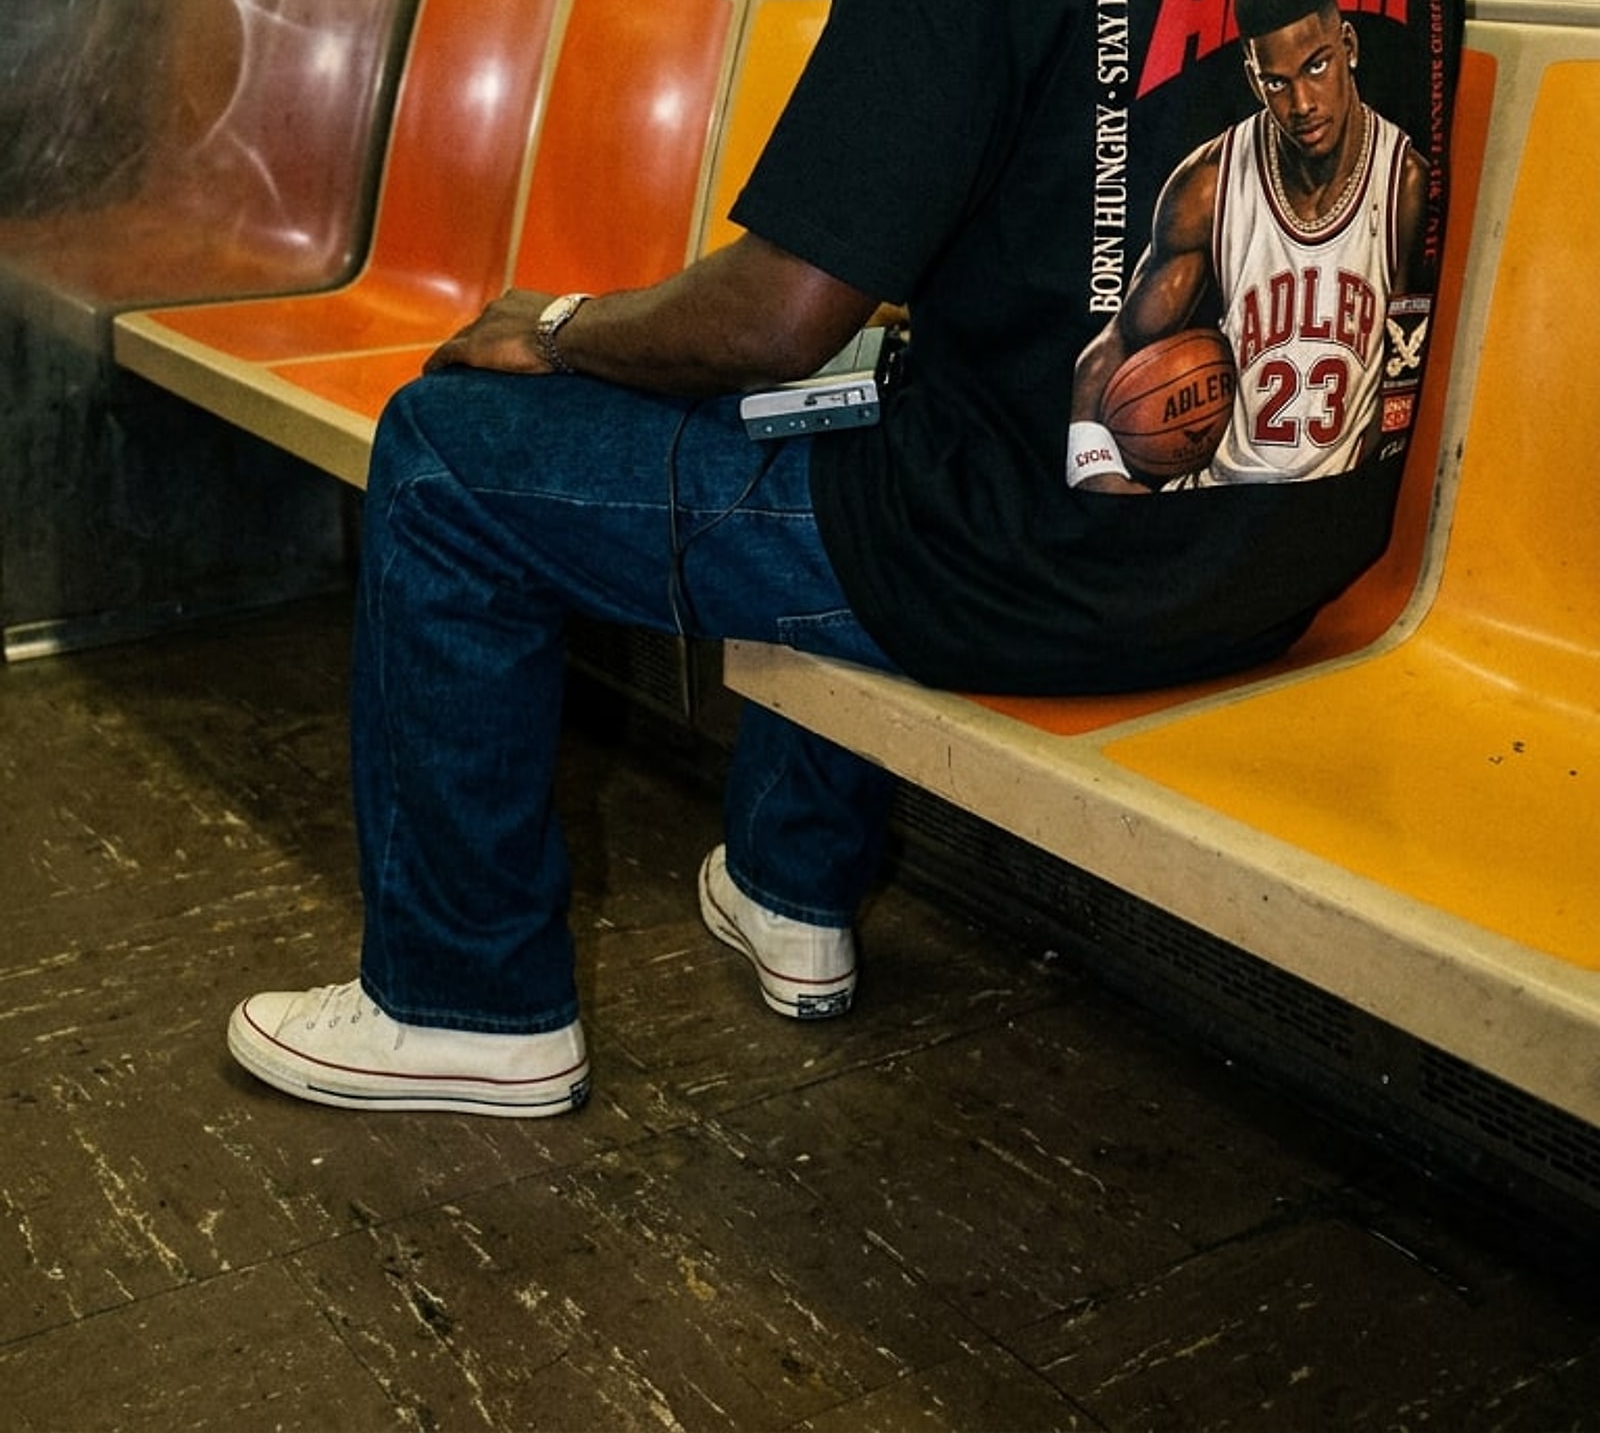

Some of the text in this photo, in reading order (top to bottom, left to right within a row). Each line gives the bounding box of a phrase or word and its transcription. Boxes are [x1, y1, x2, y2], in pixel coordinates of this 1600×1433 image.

[1097, 12, 1129, 84] STAY
[1094, 103, 1128, 228] HUNGRY
[1089, 235, 1124, 314] BORN
[1239, 266, 1377, 365] ADLER
[1252, 358, 1350, 447] 23
